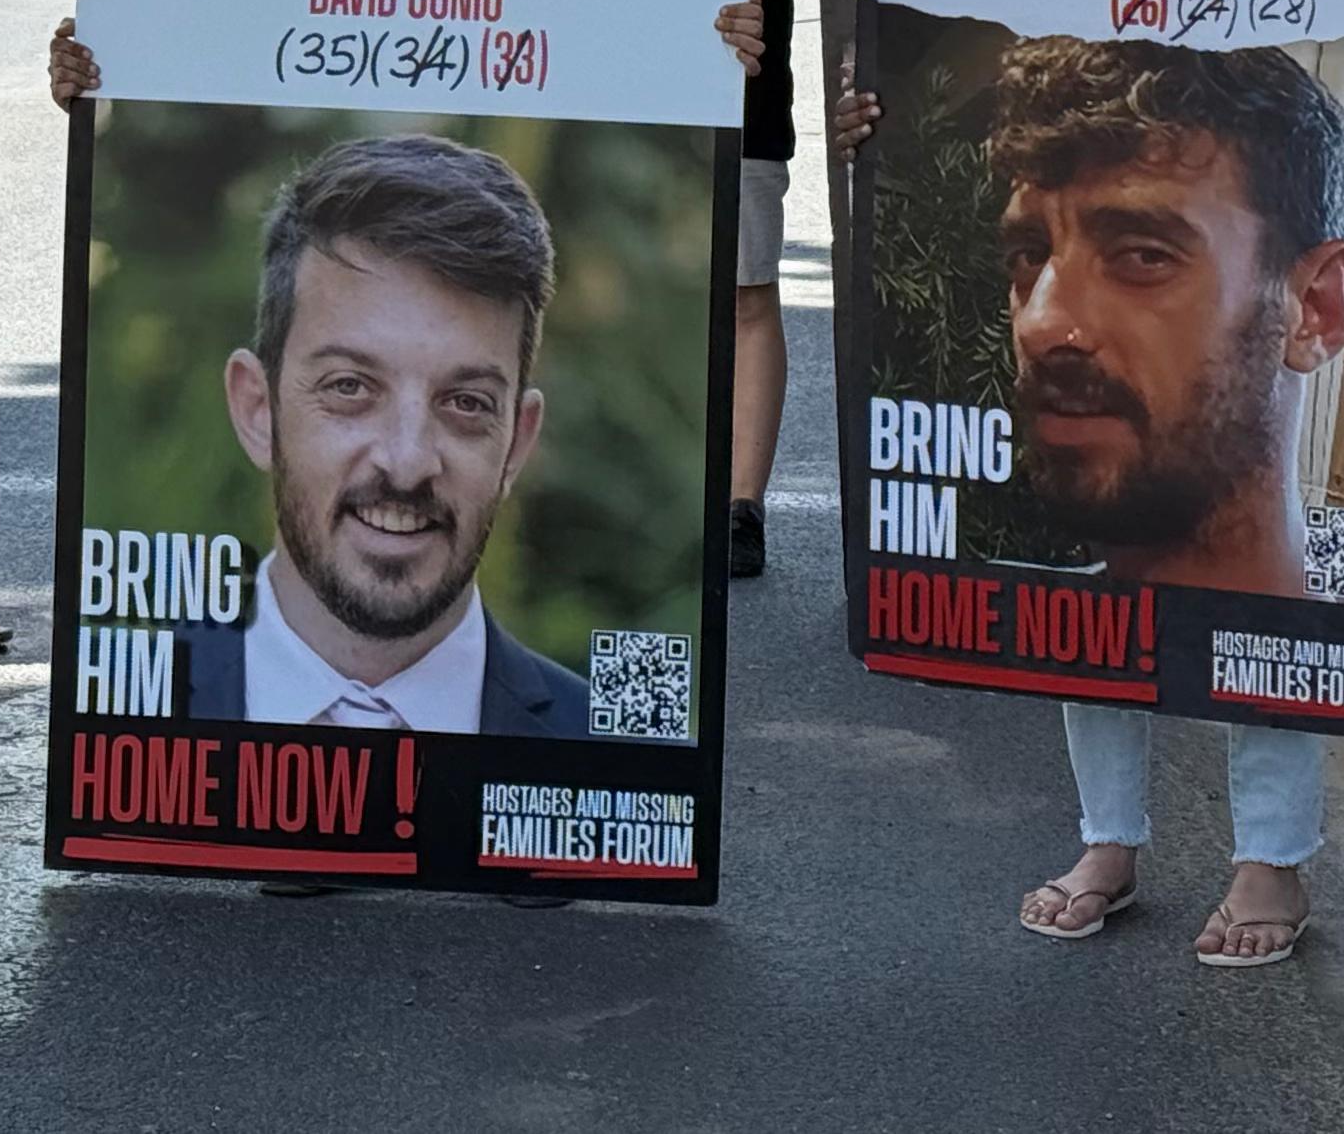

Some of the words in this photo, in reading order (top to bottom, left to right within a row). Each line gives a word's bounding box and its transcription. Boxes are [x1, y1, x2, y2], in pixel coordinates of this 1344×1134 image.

[276, 27, 369, 87] (35)
[869, 396, 1013, 484] BRING
[869, 478, 957, 560] HIM
[80, 527, 243, 624] BRING
[866, 567, 1001, 654] HOME
[1014, 582, 1156, 674] NOW!
[1212, 630, 1291, 661] HOSTAGES
[1292, 639, 1326, 666] AND
[75, 625, 174, 718] HIM
[1212, 656, 1313, 703] FAMILIES
[70, 732, 221, 827] HOME
[482, 783, 573, 817] HOSTAGES
[575, 789, 613, 820] AND
[614, 791, 695, 825] MISSING
[481, 812, 598, 864] FAMILIES
[601, 823, 694, 869] FORUM
